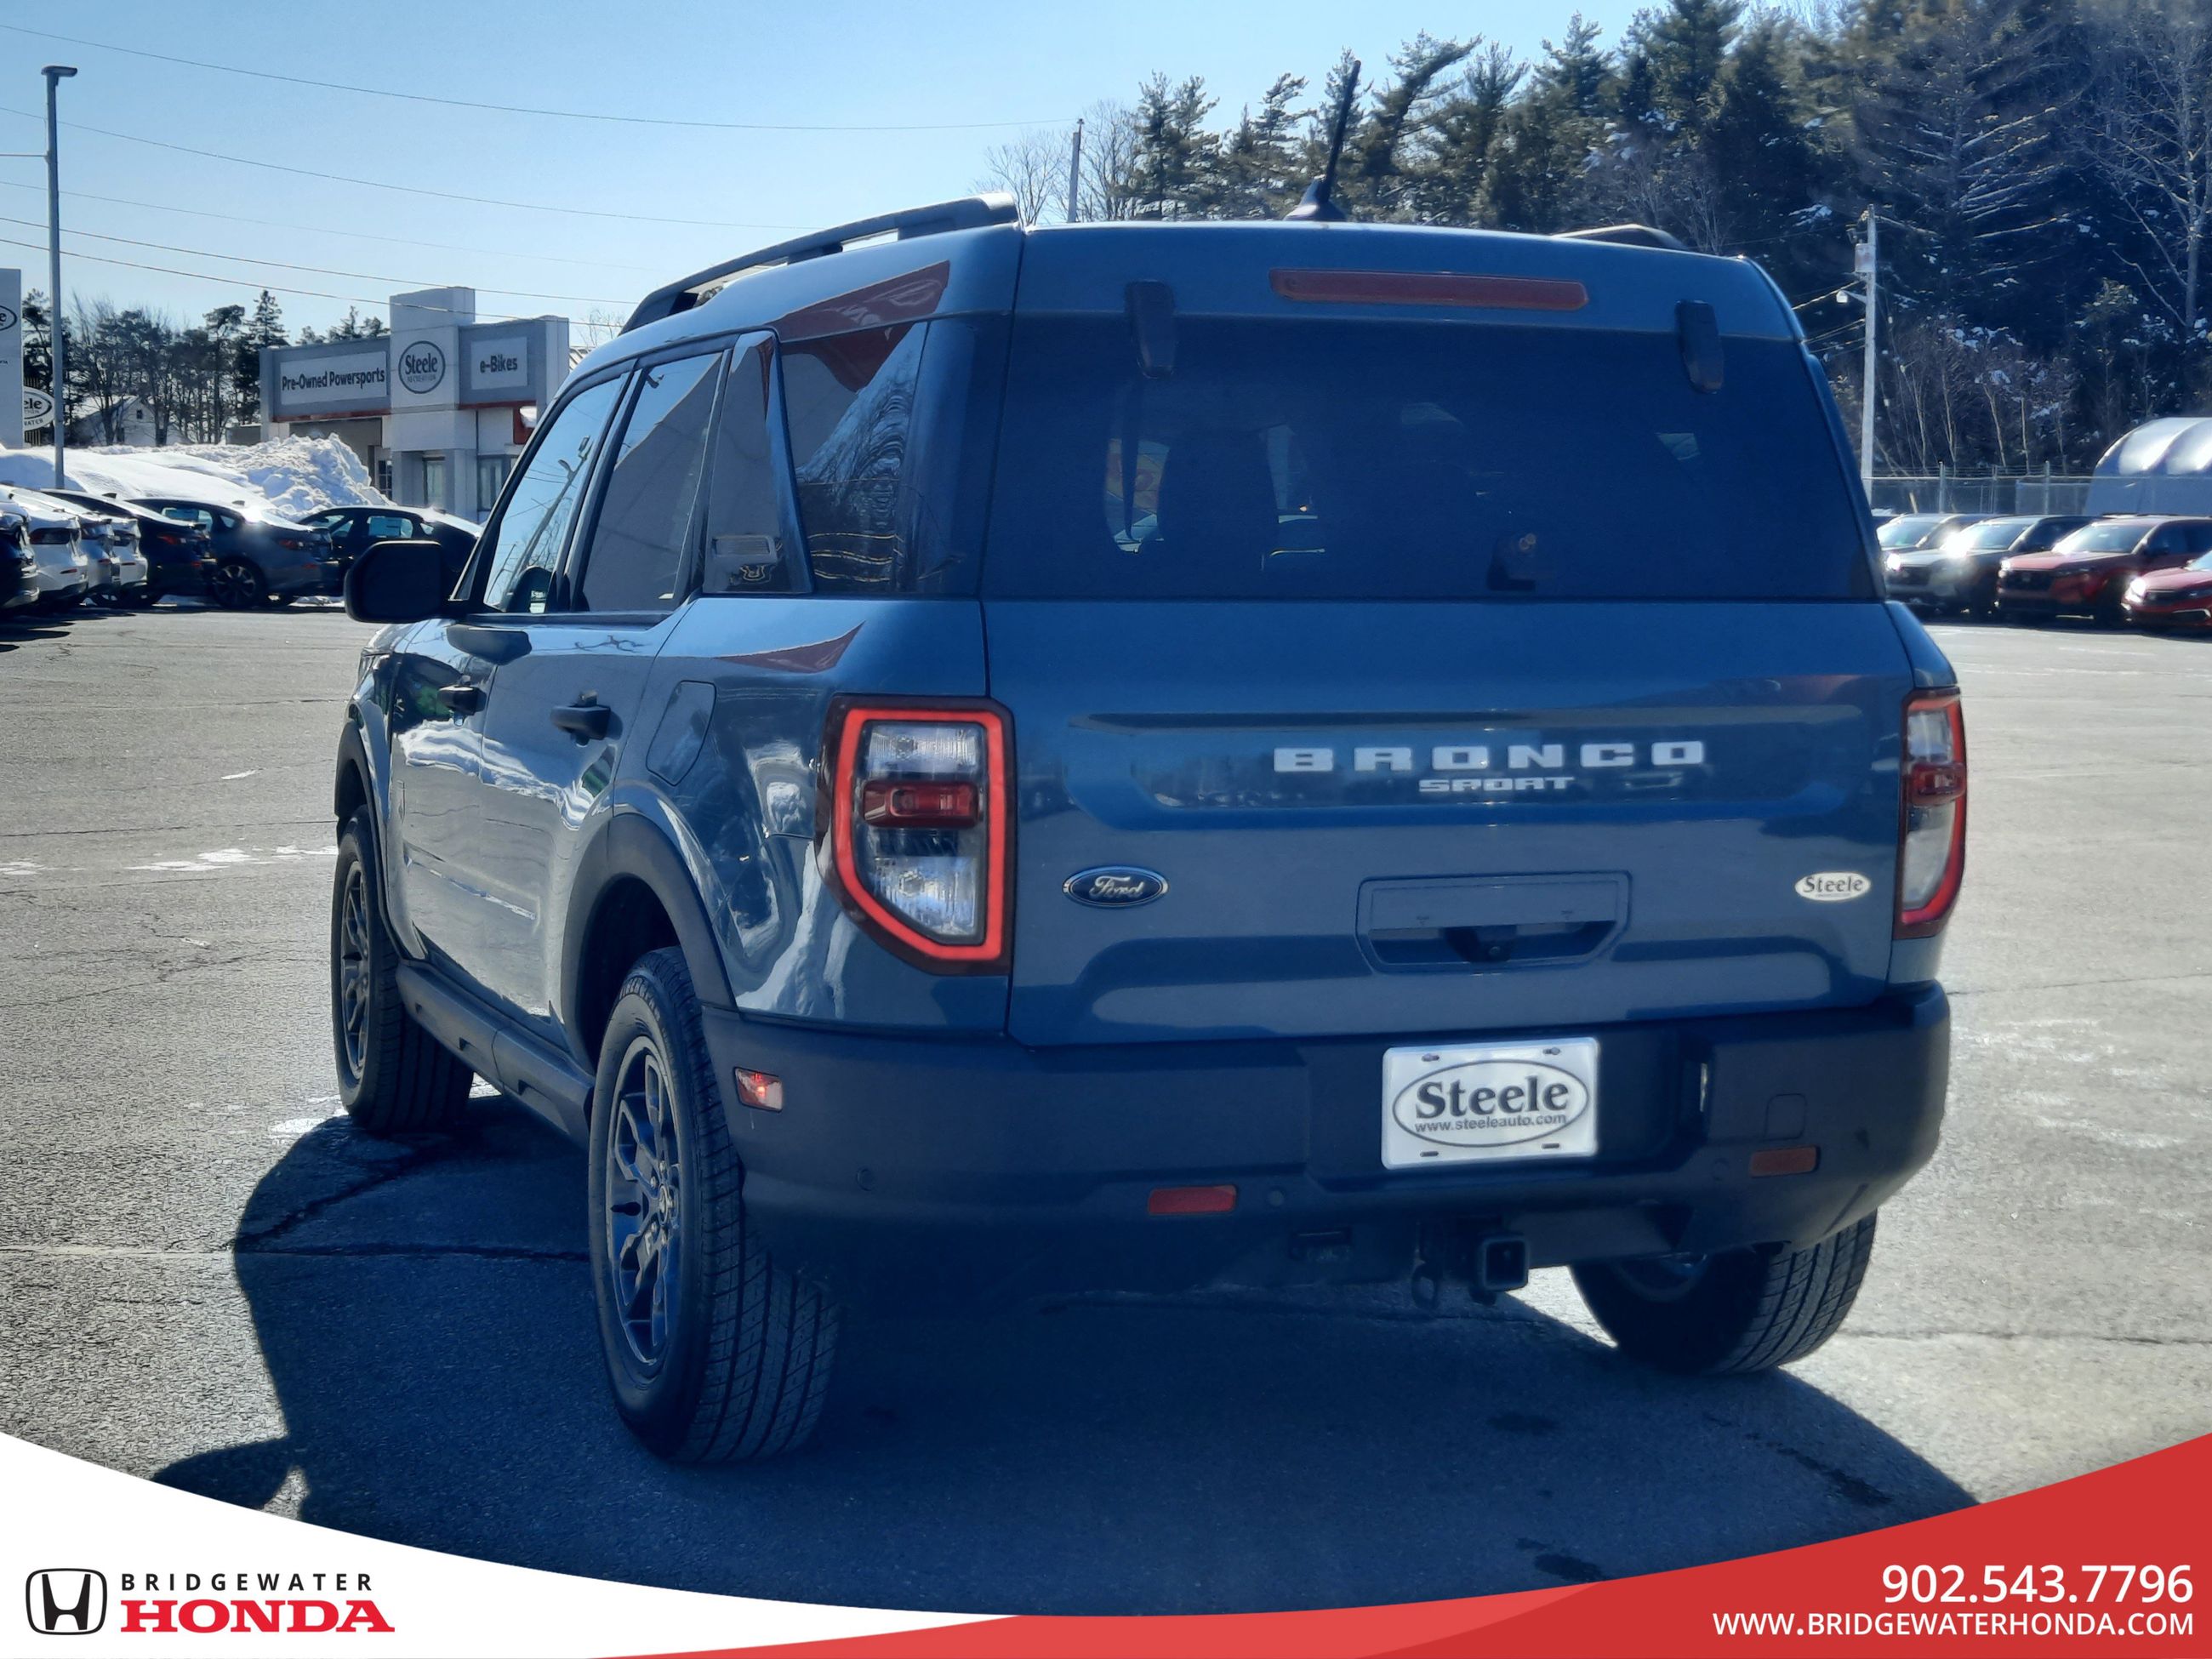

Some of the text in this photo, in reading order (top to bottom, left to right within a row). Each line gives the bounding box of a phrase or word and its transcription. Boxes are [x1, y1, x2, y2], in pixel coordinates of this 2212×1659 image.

[405, 353, 437, 374] Steele
[480, 354, 518, 373] e-Bikes
[282, 367, 385, 391] Pre-Owned Powersports
[1274, 740, 1704, 772] BRONCO
[1418, 777, 1575, 792] SPORT
[1089, 875, 1144, 899] Ford
[1803, 875, 1863, 892] Steele
[1415, 1075, 1569, 1119] Steele
[1414, 1113, 1567, 1133] www.steeleauto.com
